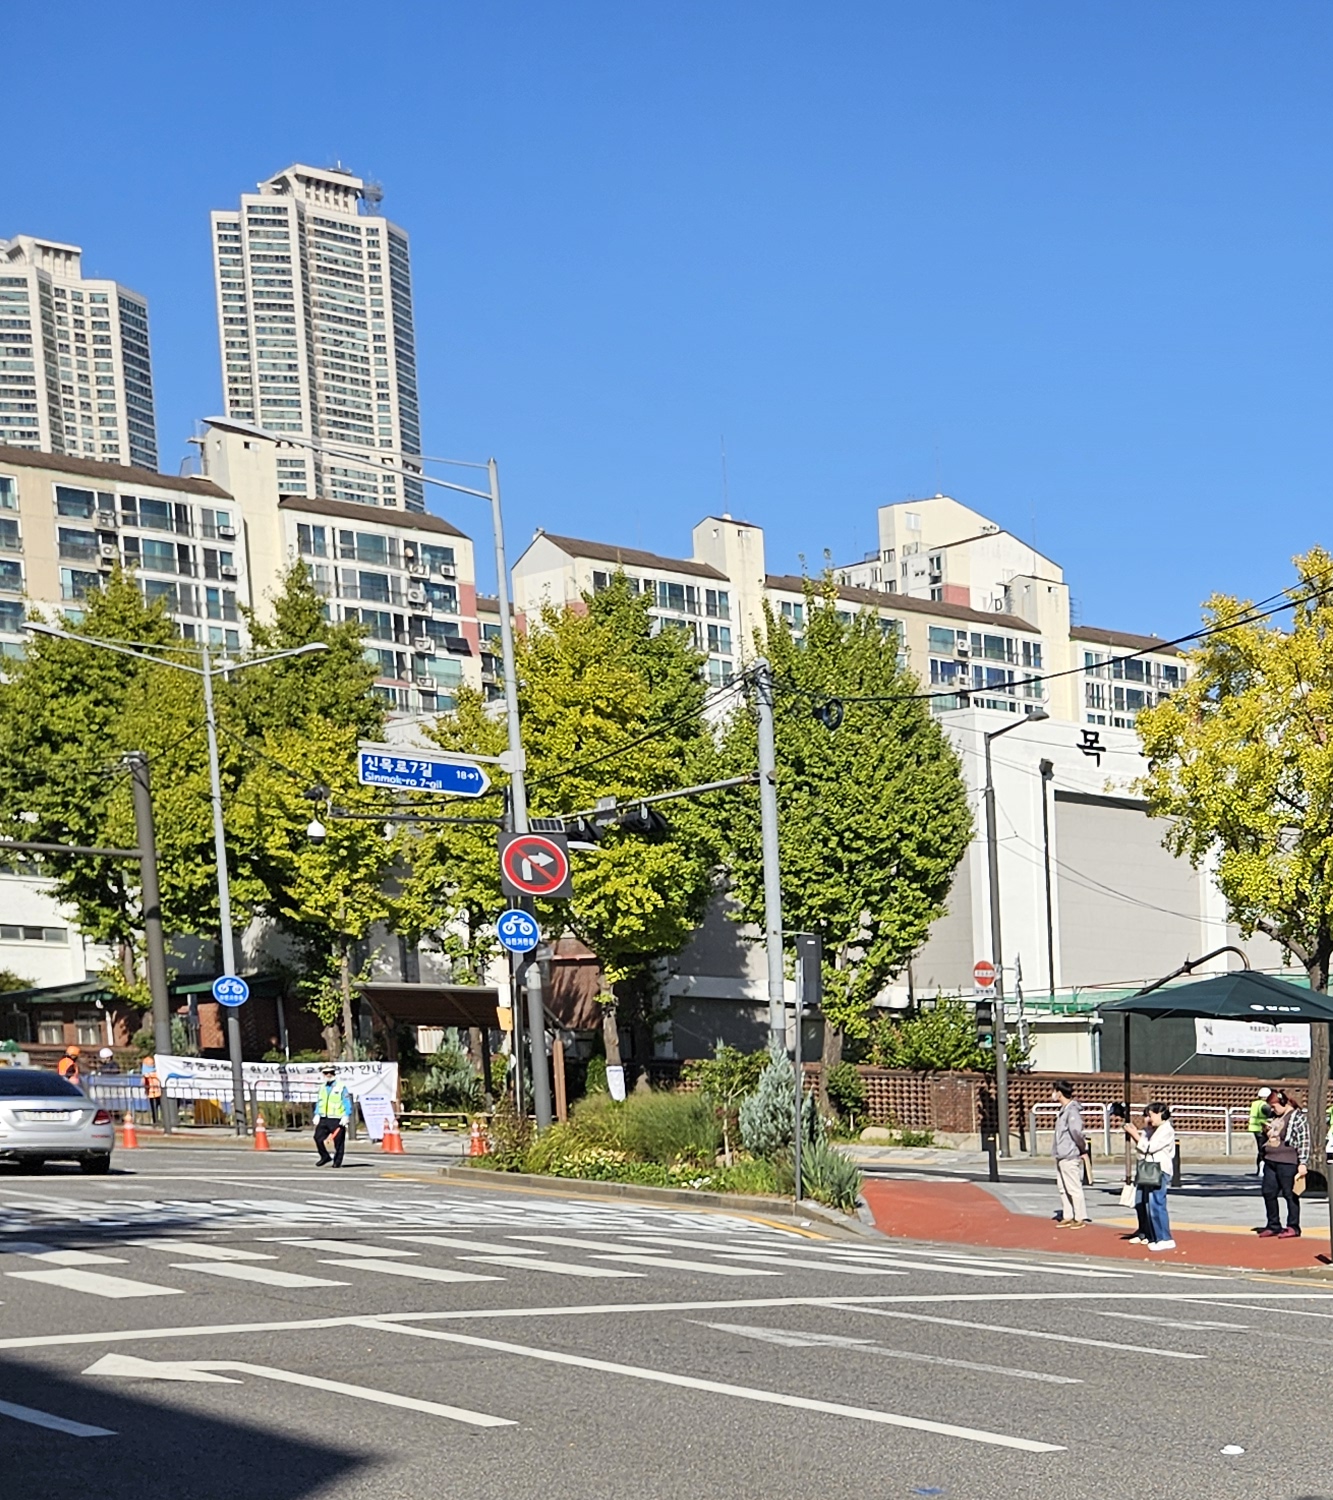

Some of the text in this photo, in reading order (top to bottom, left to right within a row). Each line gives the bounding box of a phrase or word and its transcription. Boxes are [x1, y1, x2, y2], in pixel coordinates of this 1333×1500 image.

[365, 756, 432, 778] 신목로7길
[364, 771, 443, 790] Sinmok-ro 7-gil
